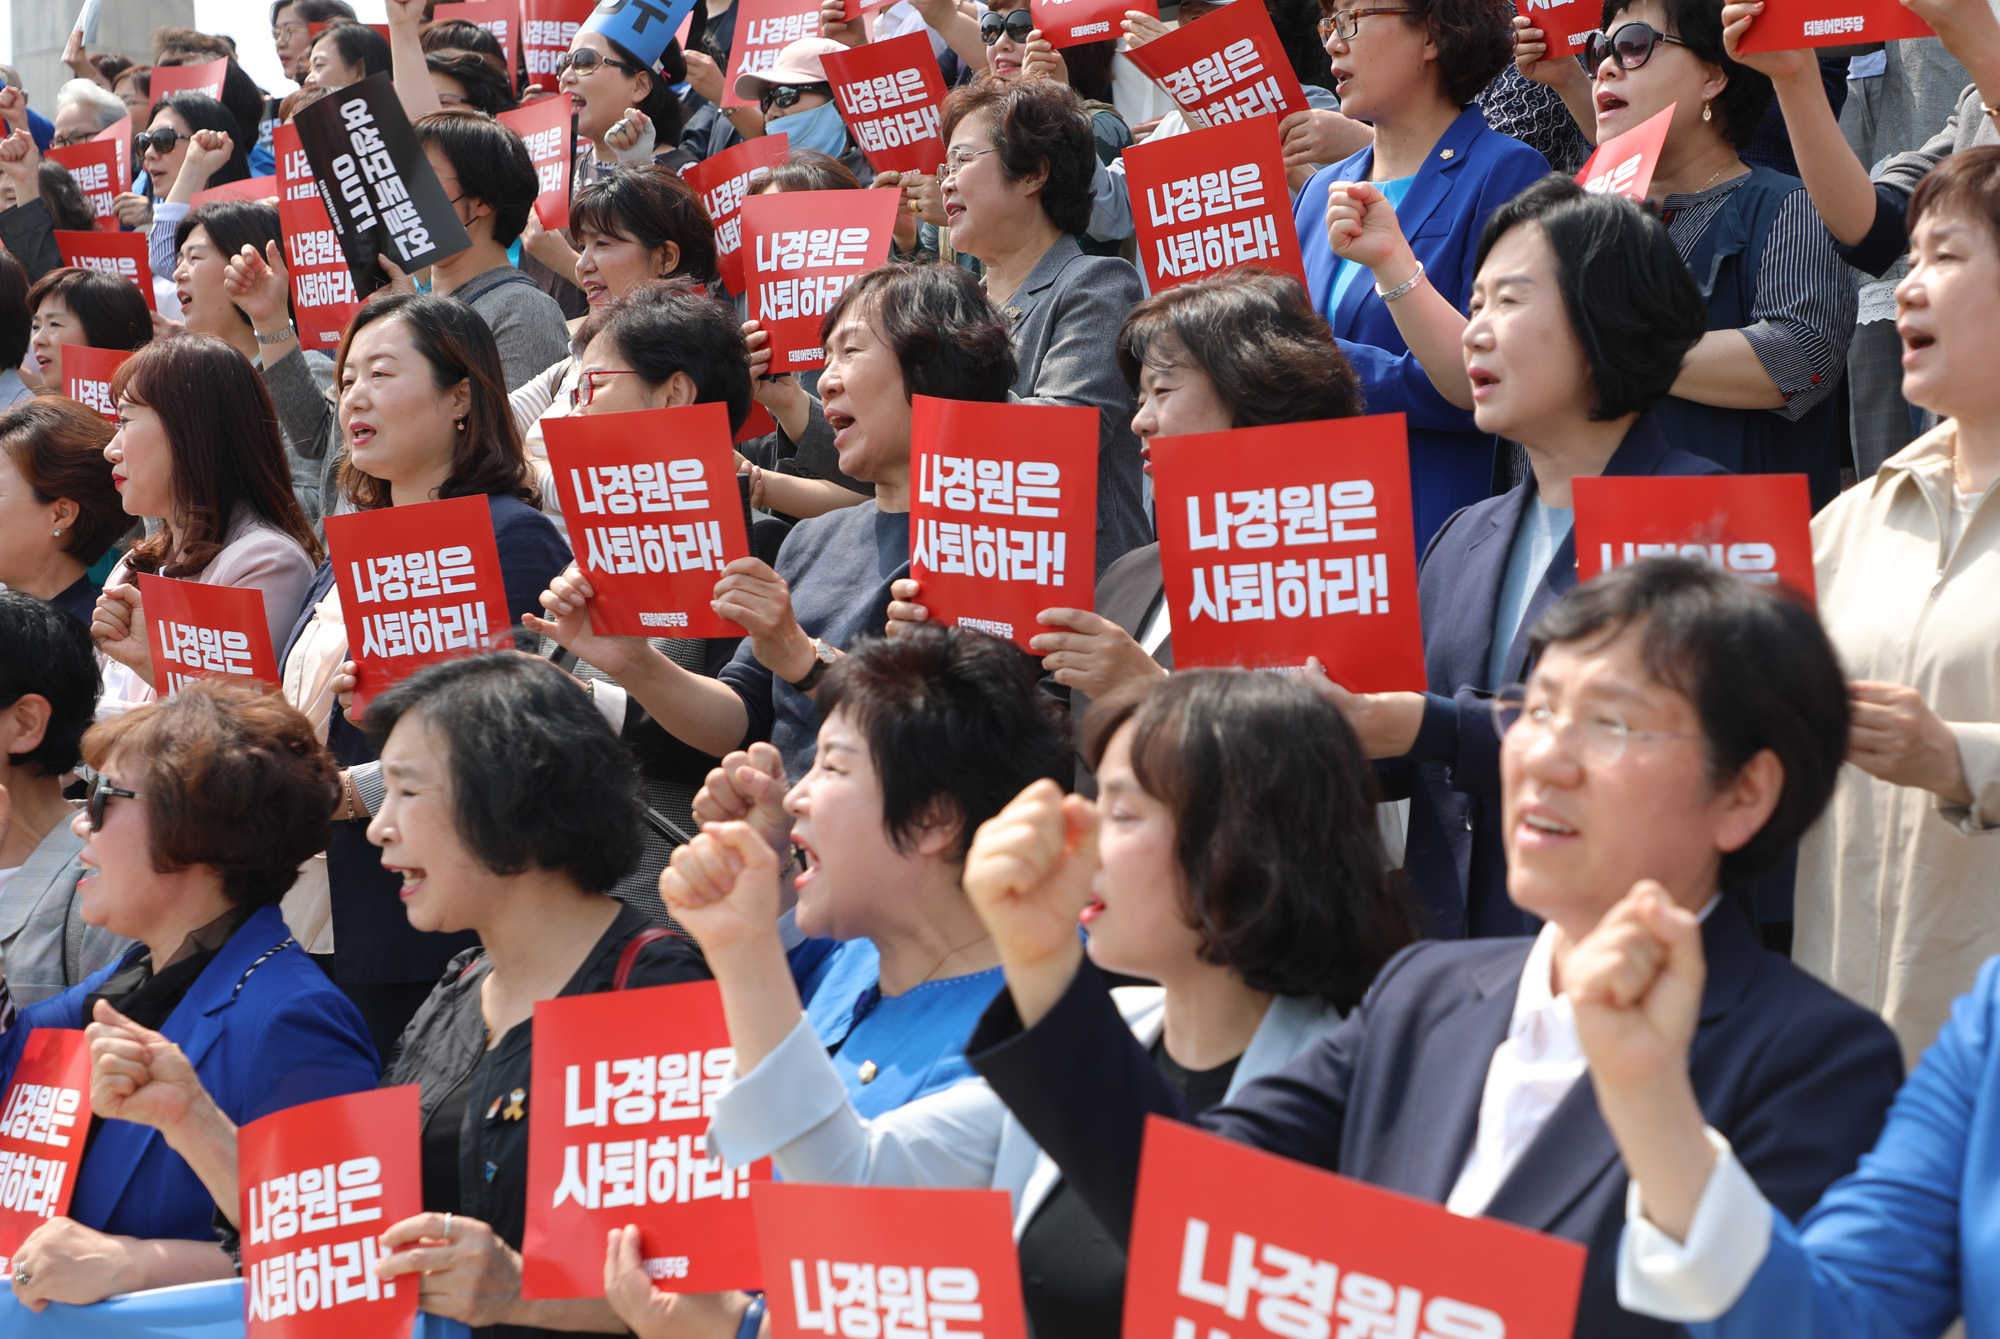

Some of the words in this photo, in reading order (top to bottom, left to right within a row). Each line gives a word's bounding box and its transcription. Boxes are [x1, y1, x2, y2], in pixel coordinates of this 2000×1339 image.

[746, 11, 820, 46] 나경원은
[1070, 20, 1110, 38] 더불어민주당
[1803, 15, 1865, 36] 더불어민주당
[838, 67, 929, 115] 나경원은
[1156, 38, 1265, 105] 경원은
[521, 126, 562, 161] 경원은
[331, 153, 378, 234] OUT!
[703, 166, 770, 220] 나경원
[1147, 162, 1265, 228] 나경원은
[756, 227, 870, 273] 나경원은
[1155, 214, 1281, 279] 사퇴하라!
[71, 378, 117, 415] 나경원
[570, 458, 710, 515] 나경원은
[919, 452, 1061, 519] 나경원은
[1186, 479, 1378, 551] 나경원은
[350, 545, 477, 604] 나경원은
[585, 520, 726, 575] 사퇴하라!
[913, 518, 1067, 587] 사퇴하라!
[1188, 553, 1390, 623] 사퇴하라!
[157, 619, 254, 676] 나경원은
[361, 601, 492, 660] 사퇴하라!
[638, 612, 689, 627] 더불어민주당
[249, 1155, 383, 1246] 나경원은
[790, 1258, 985, 1339] 나경원은
